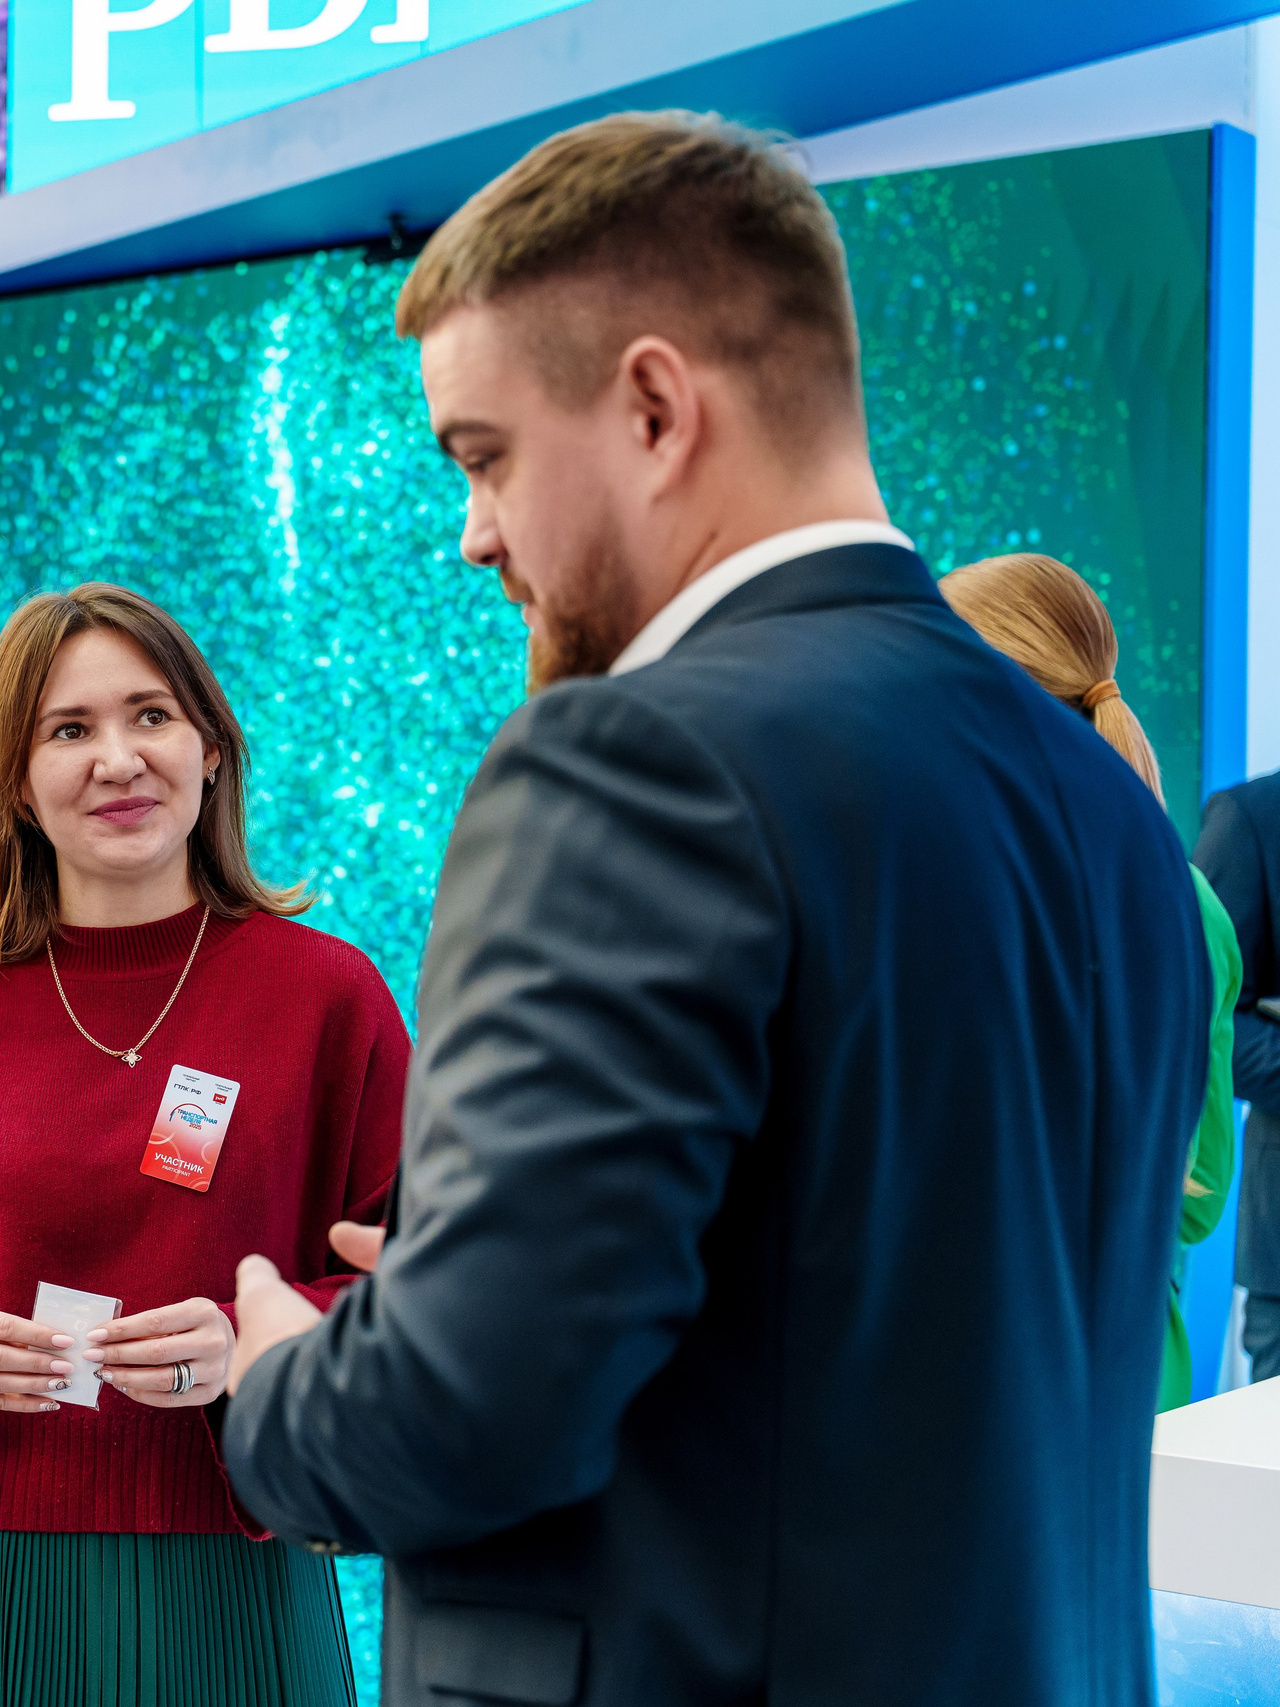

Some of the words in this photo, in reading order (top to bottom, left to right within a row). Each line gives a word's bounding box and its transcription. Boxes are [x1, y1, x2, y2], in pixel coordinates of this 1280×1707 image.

[177, 1108, 218, 1125] ТРАНСПОРТНАЯ
[154, 1152, 205, 1174] УЧАСТНИК
[161, 1164, 192, 1177] PARTICIPANT
